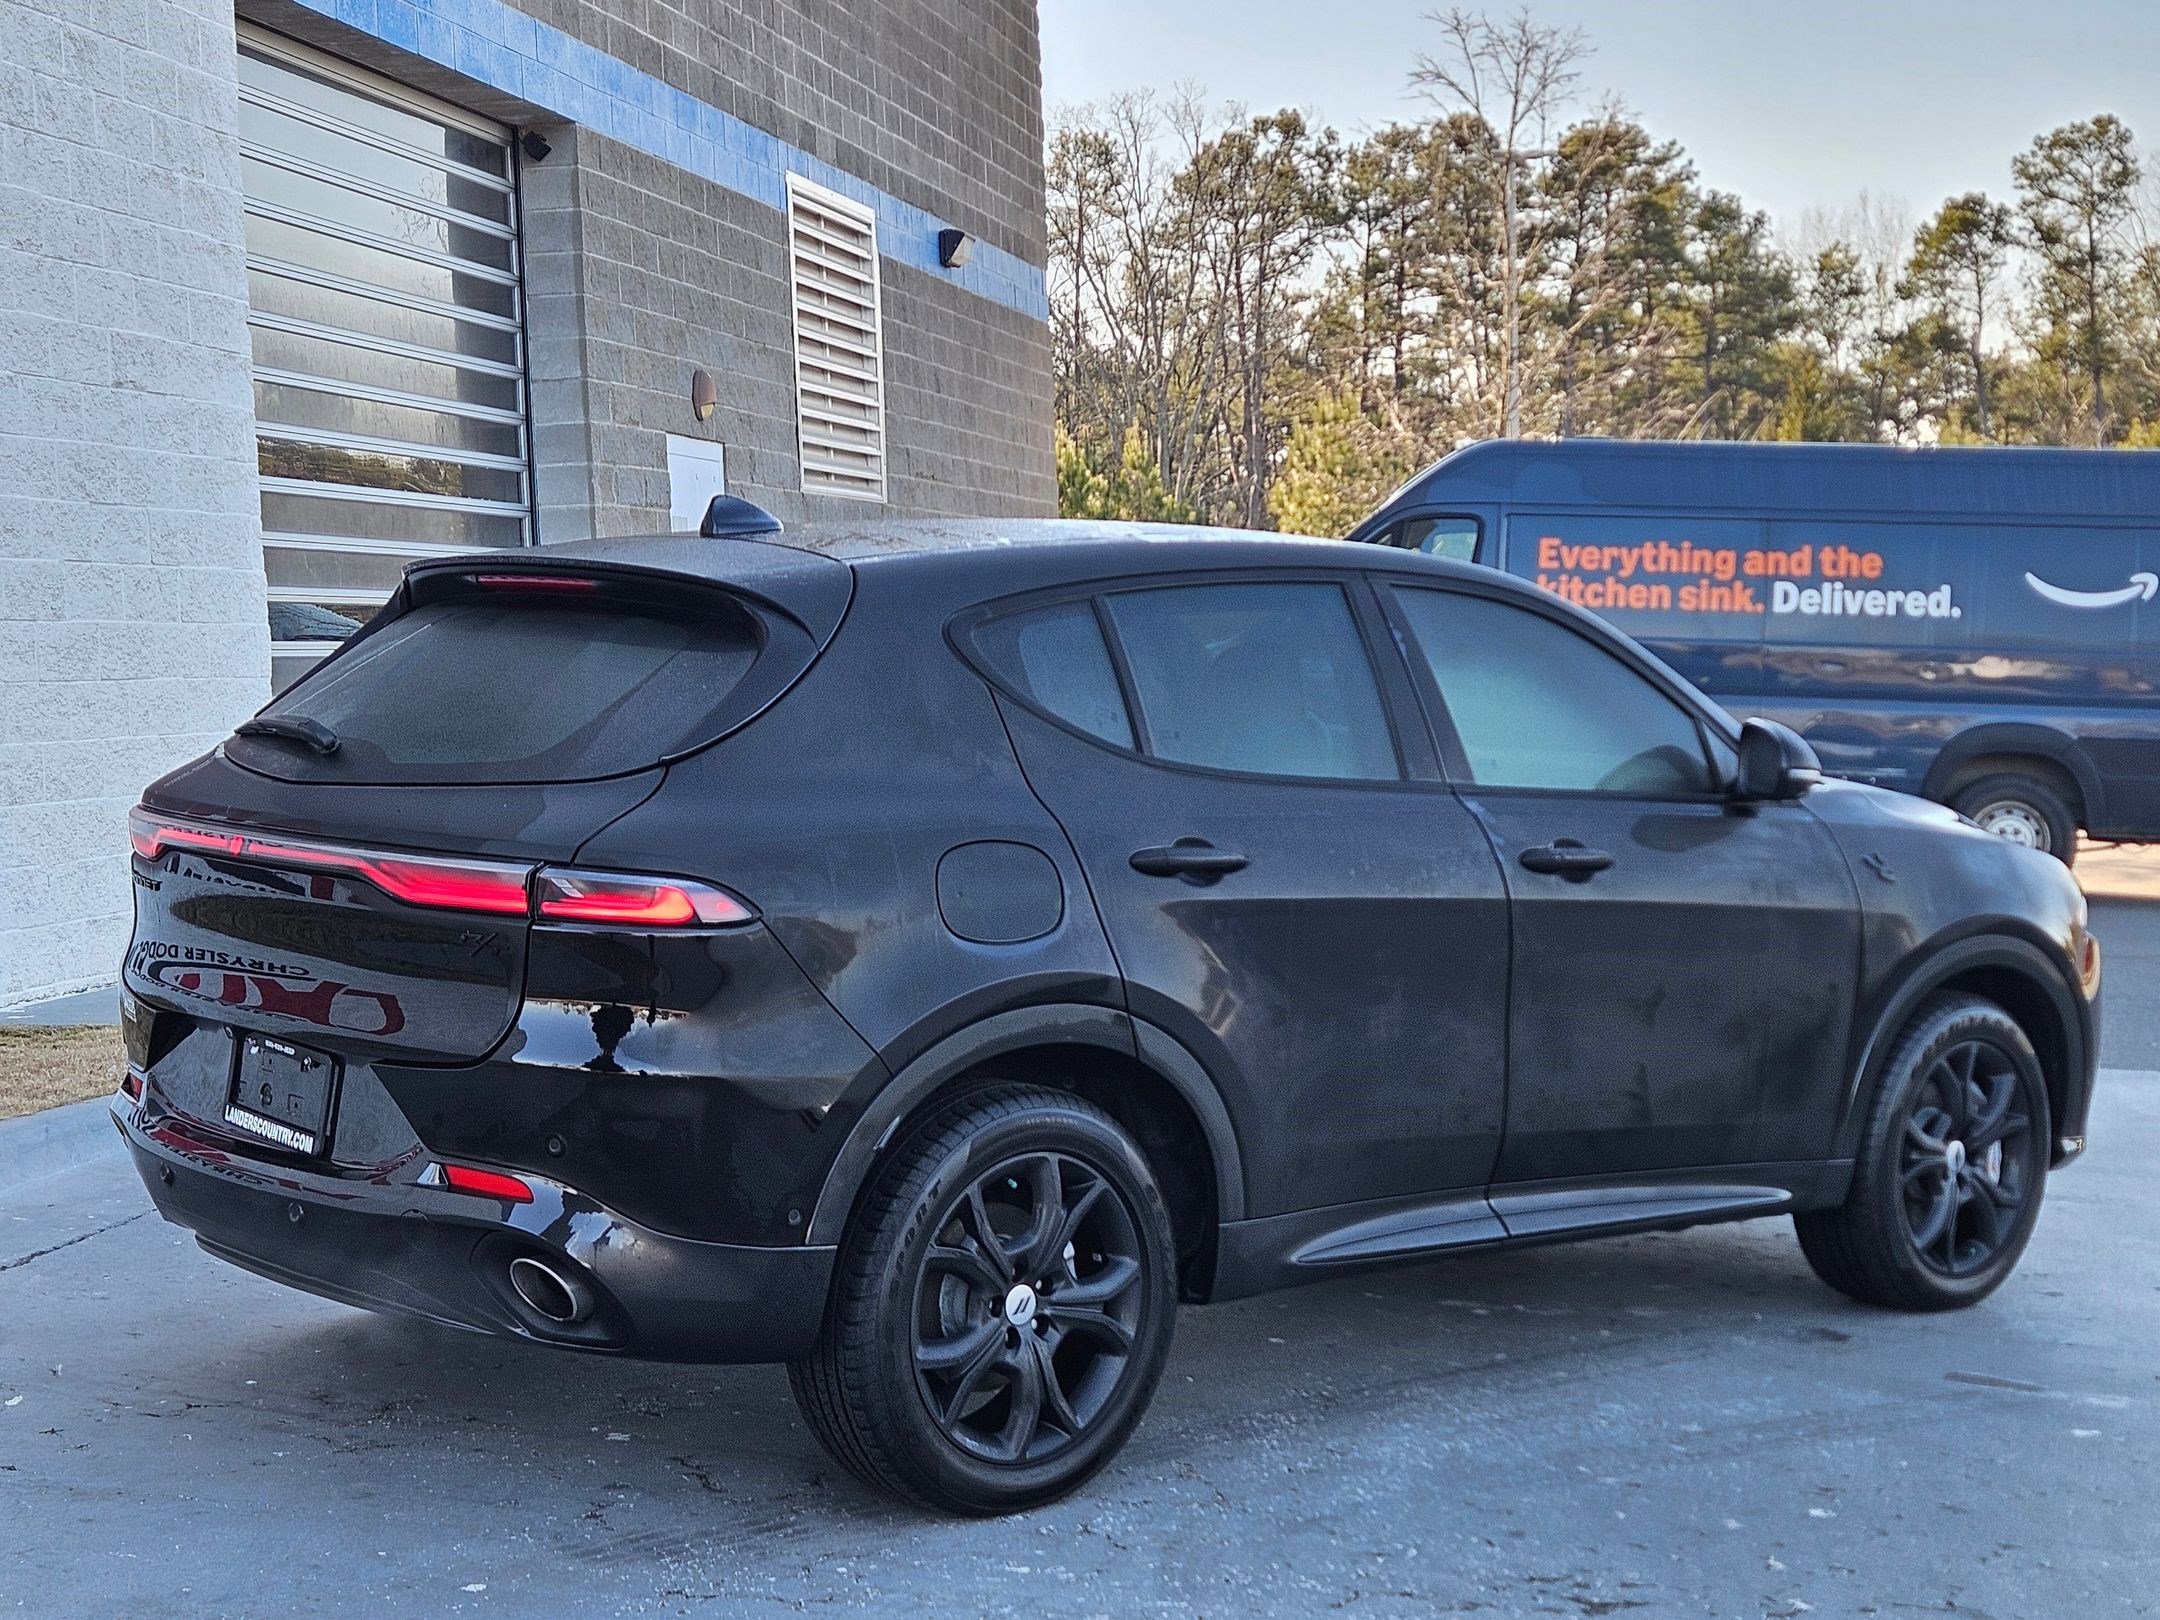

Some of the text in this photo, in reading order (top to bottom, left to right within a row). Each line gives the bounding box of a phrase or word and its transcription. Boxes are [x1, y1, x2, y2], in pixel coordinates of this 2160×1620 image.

[1538, 537, 1883, 581] Everything and the
[1679, 578, 1765, 613] sink.
[1773, 581, 1962, 619] Delivered.
[185, 945, 310, 976] CHRYSLER
[224, 1104, 314, 1155] LANDERSCOUNTRY.COM
